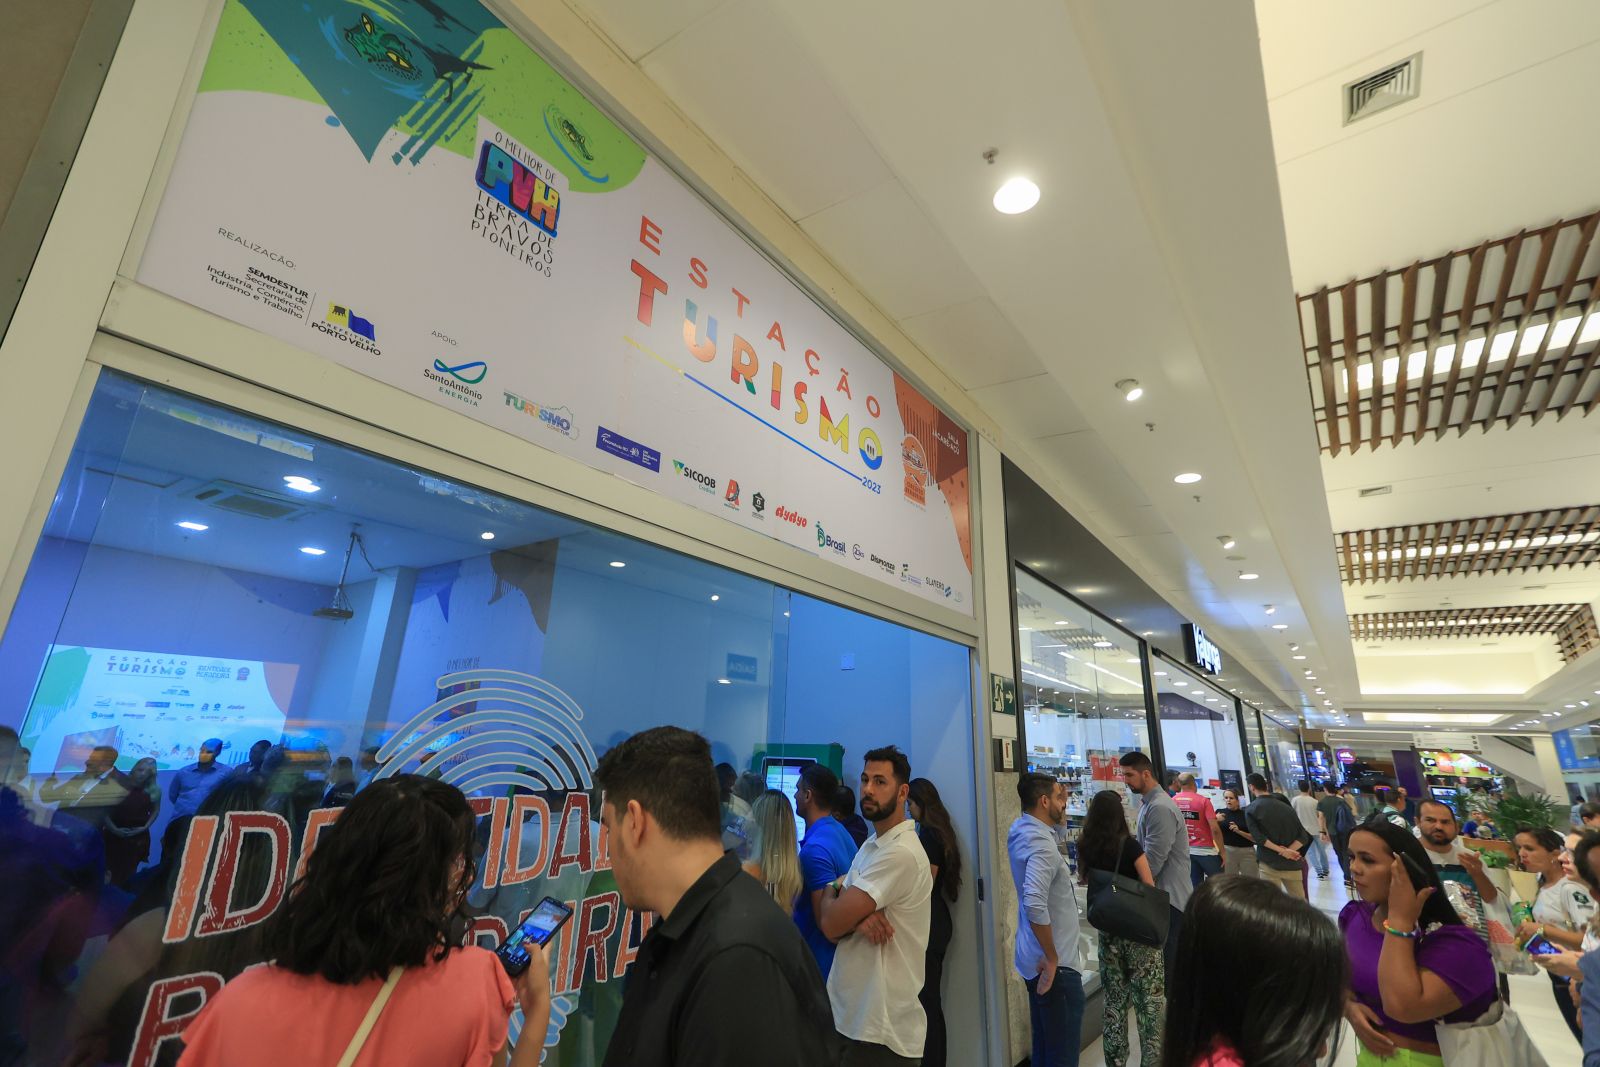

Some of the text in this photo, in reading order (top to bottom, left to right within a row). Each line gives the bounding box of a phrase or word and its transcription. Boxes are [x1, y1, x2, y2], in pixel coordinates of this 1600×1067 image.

[495, 131, 556, 185] O MELHOR DE
[483, 141, 560, 233] PVH
[474, 203, 553, 264] BRAVOS
[477, 189, 555, 249] TERRA DE
[217, 227, 297, 270] REALIZAÇÃO:
[471, 219, 552, 278] PIONEIROS
[209, 274, 251, 297] Turismo
[262, 298, 303, 319] Trabalho
[245, 273, 308, 306] Secretaria de
[248, 266, 309, 299] SEMDESTUR
[320, 320, 376, 347] PREFEITURA
[639, 214, 881, 419] ESTAÇÃO
[311, 321, 381, 356] PORTO VELHO
[630, 259, 883, 471] TURISMO
[438, 386, 479, 407] ENERGIA
[503, 391, 571, 432] TURISMO
[684, 467, 716, 488] SICOOB
[862, 476, 882, 494] 2023
[775, 505, 807, 527] dydyo
[826, 535, 847, 553] Brasil
[106, 662, 187, 676] TURISMO
